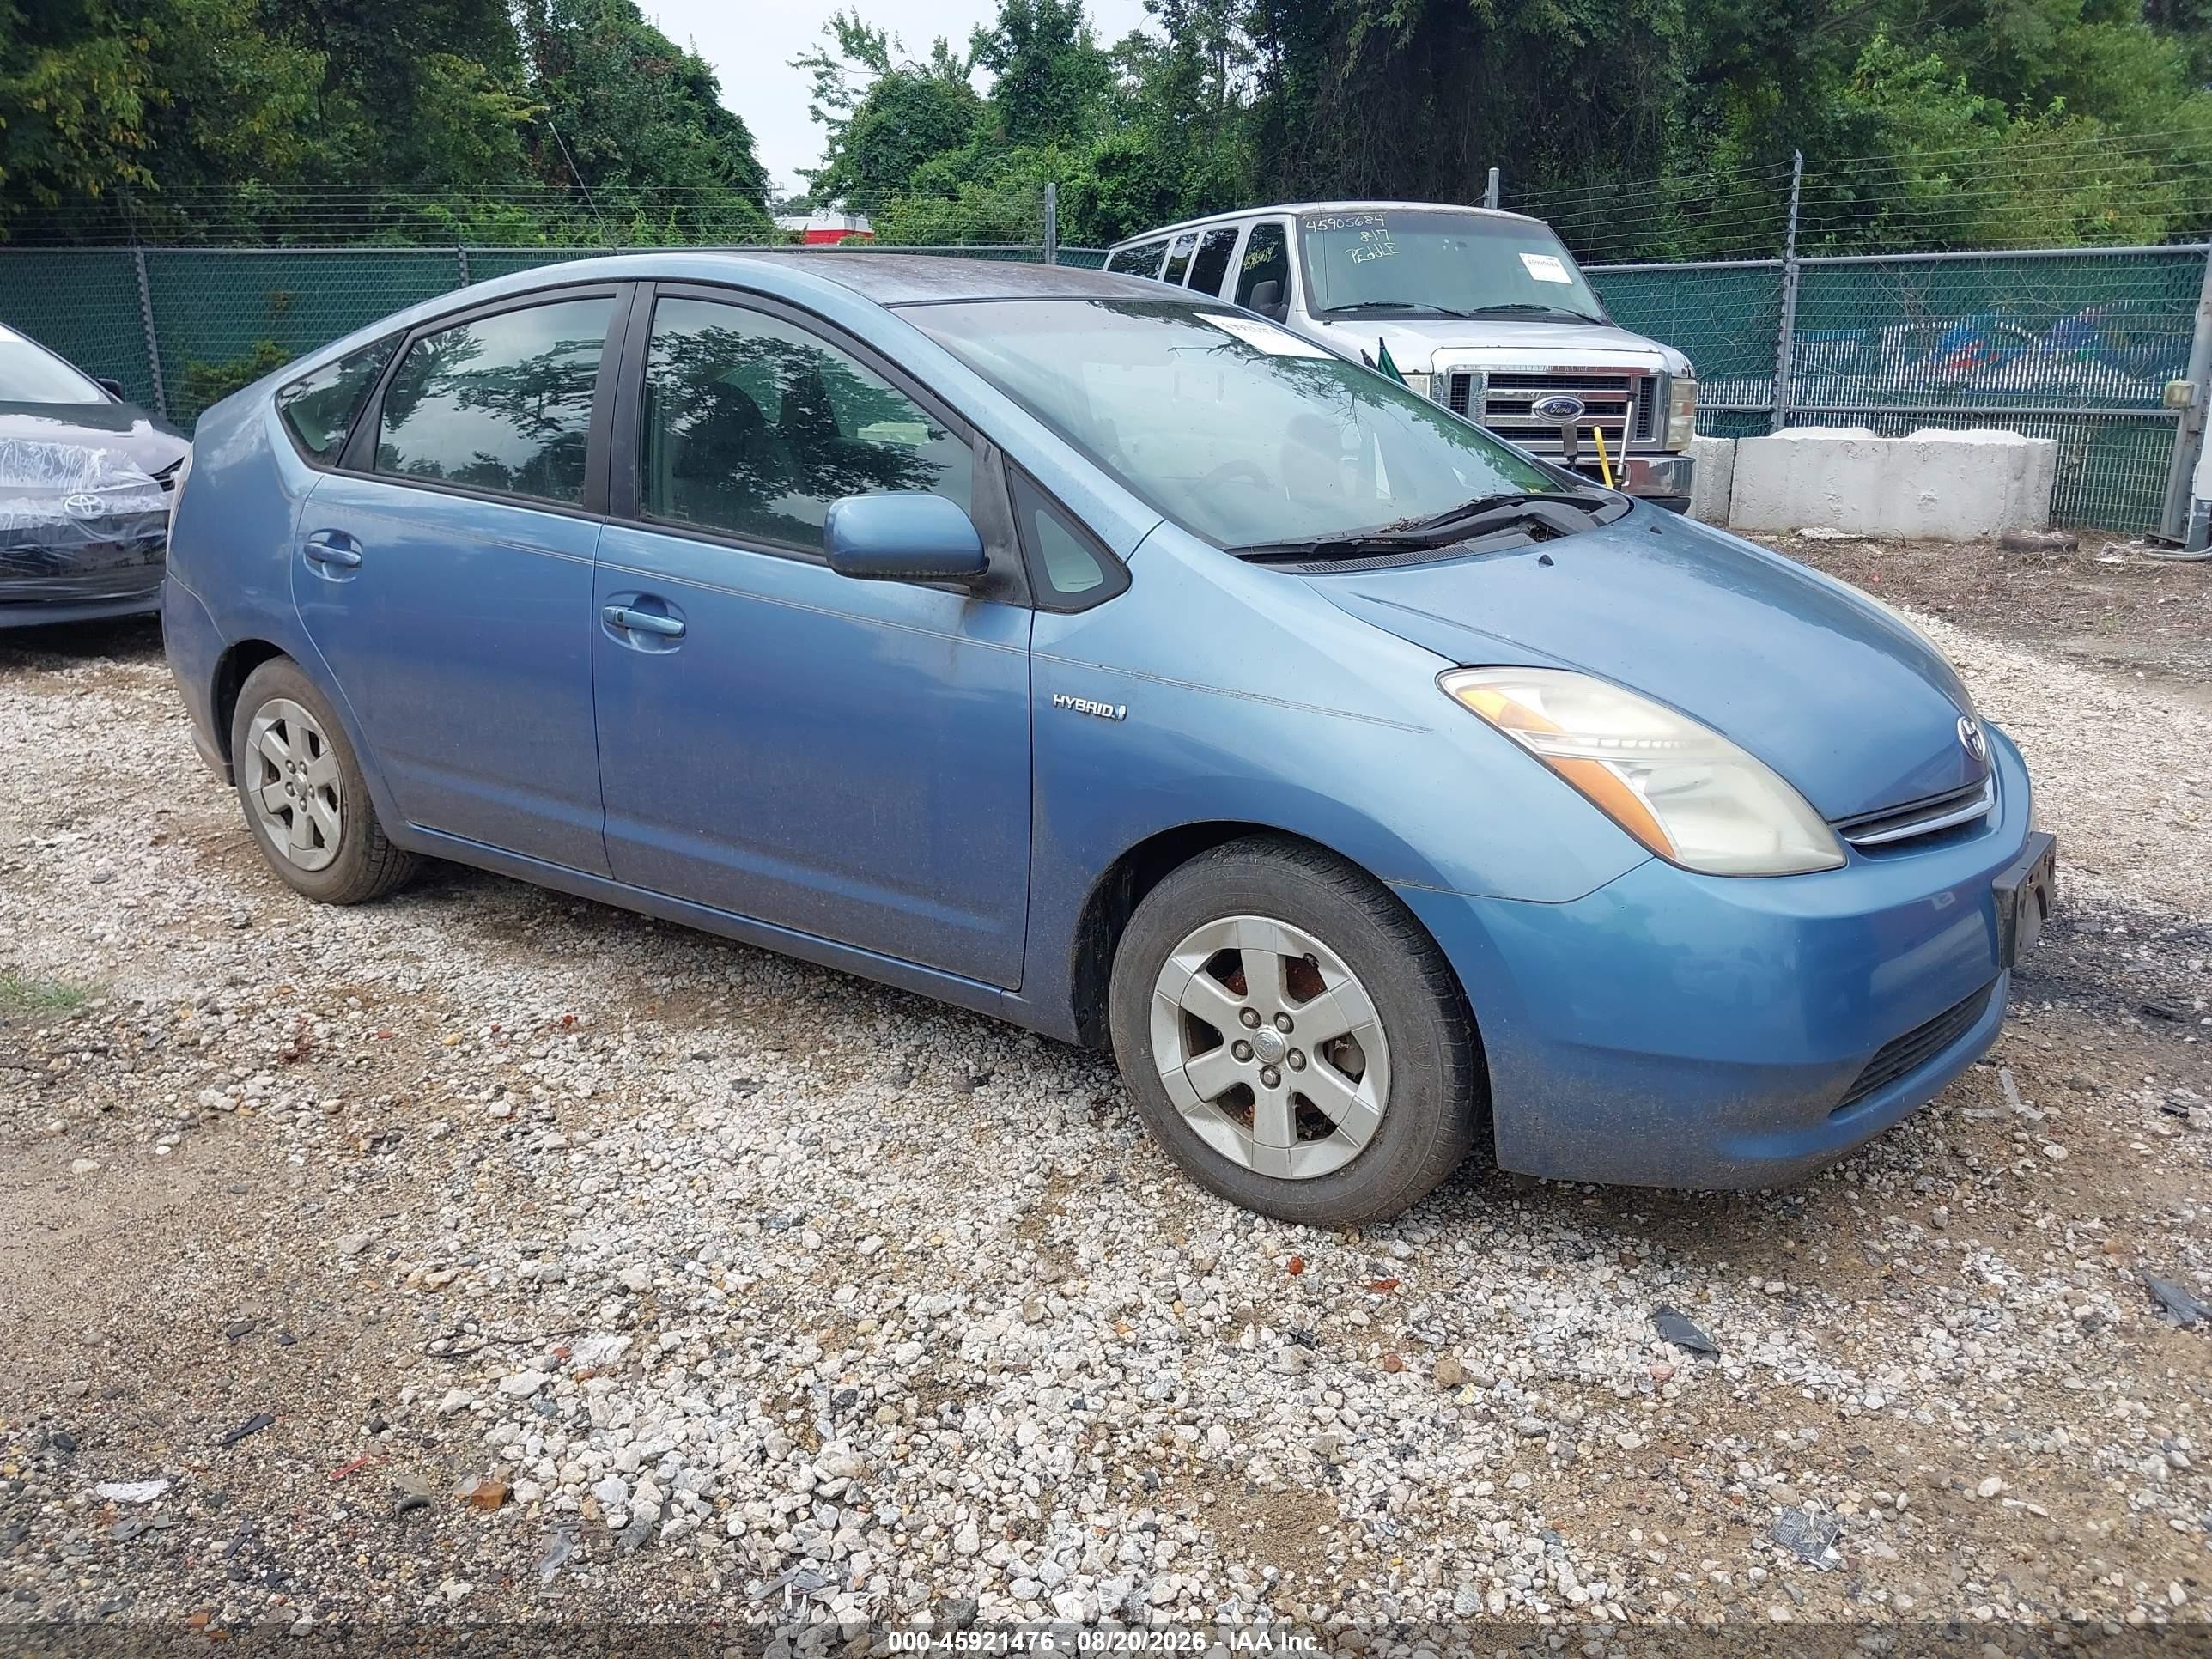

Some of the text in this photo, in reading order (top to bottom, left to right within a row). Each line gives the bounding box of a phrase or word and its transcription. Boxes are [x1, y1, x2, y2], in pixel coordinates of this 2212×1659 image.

[1305, 214, 1385, 233] 45905684
[1550, 402, 1572, 414] Ford
[1053, 693, 1115, 718] HYBRID
